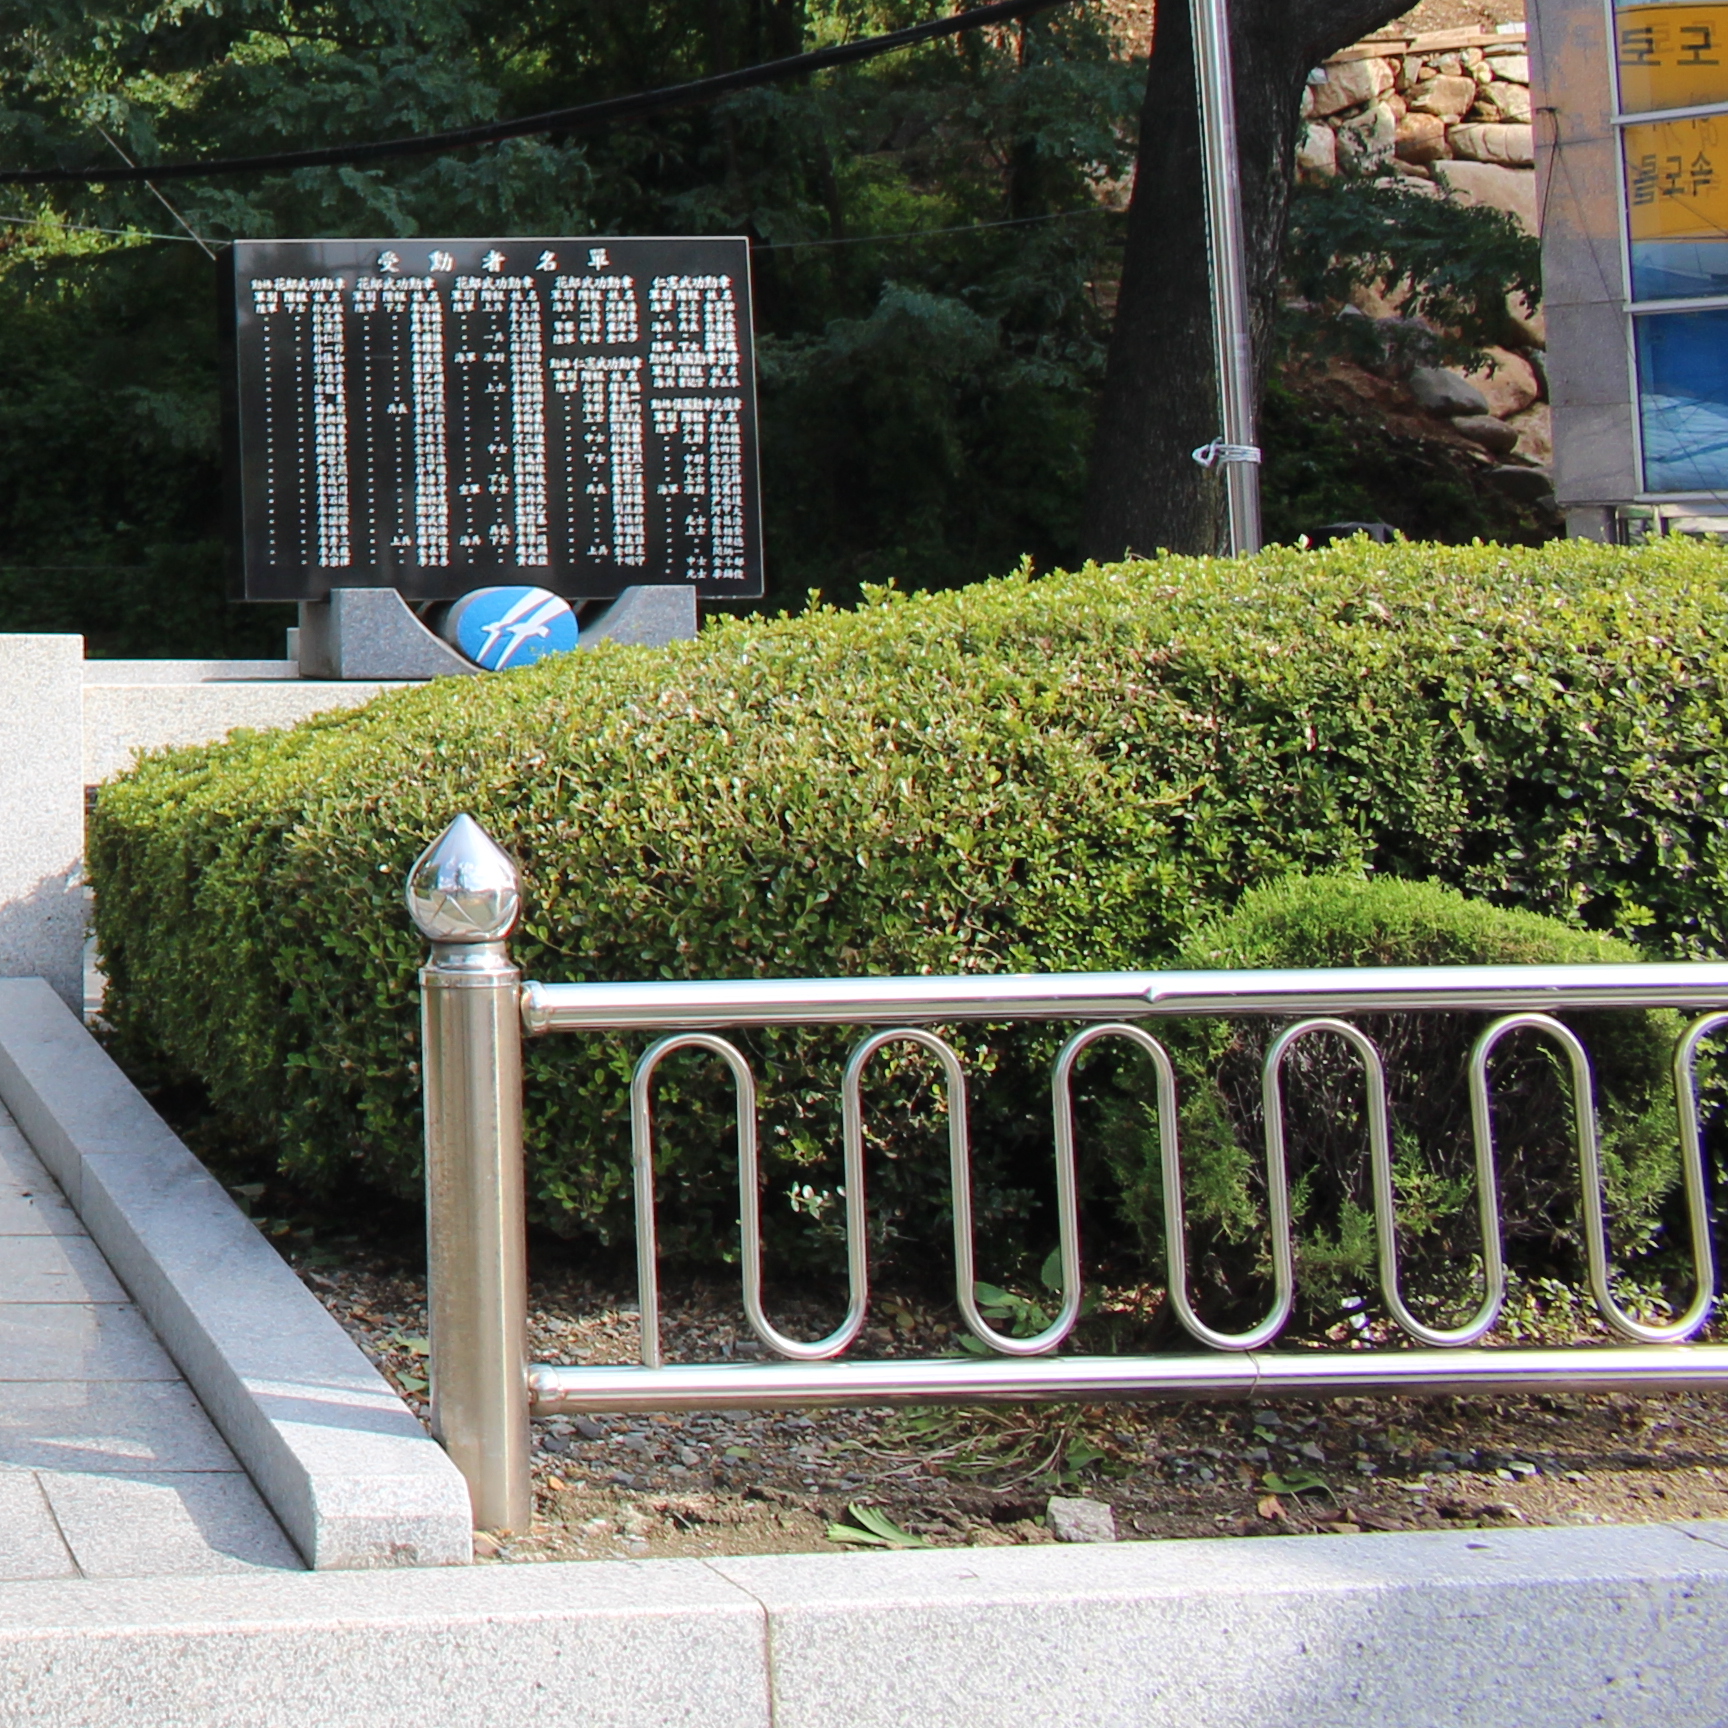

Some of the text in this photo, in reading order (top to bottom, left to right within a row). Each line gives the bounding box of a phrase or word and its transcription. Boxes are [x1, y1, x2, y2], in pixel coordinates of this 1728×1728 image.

[377, 248, 610, 273] 受勳者名單
